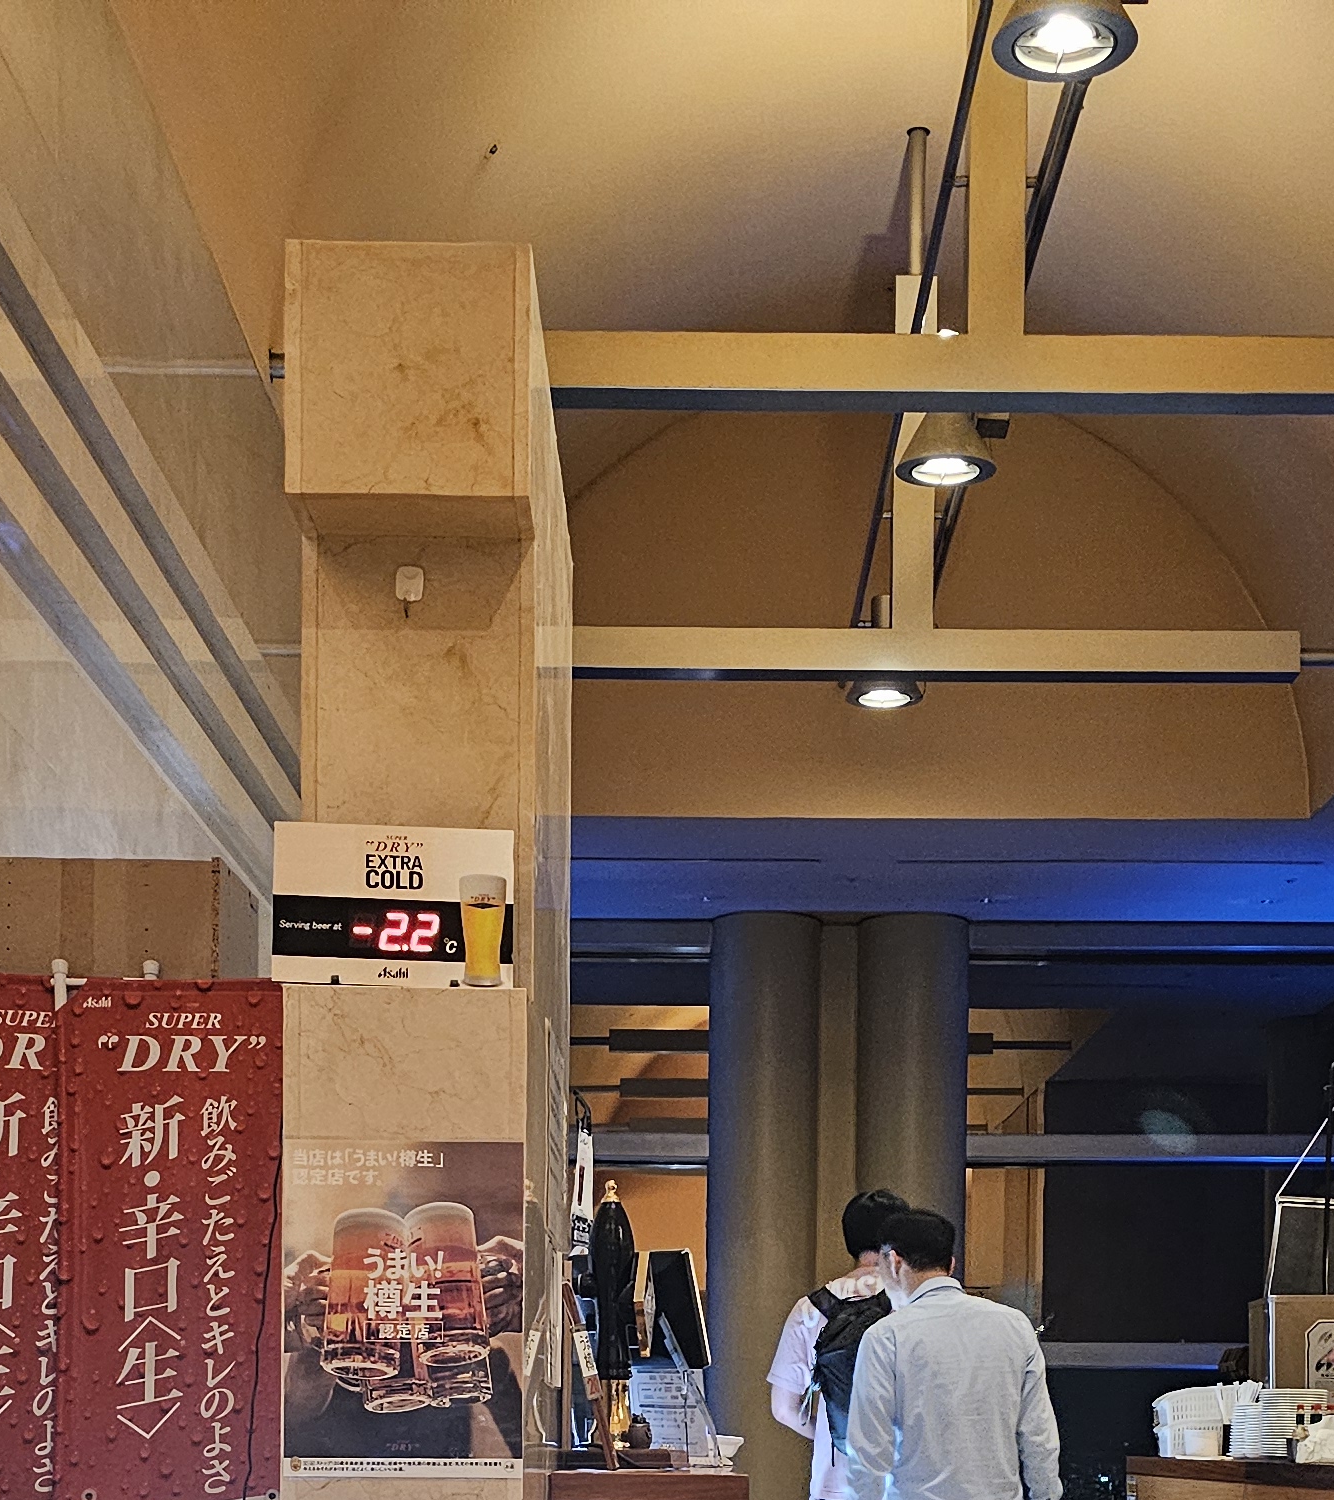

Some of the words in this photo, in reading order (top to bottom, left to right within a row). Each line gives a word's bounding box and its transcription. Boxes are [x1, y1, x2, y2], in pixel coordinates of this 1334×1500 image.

[365, 854, 423, 870] EXTRA
[365, 869, 424, 890] COLD
[279, 919, 310, 932] Serving
[312, 920, 332, 931] beer
[333, 921, 342, 931] at
[377, 966, 410, 980] Asahi
[83, 996, 112, 1008] Asahi
[145, 1012, 222, 1029] SUPER
[292, 1169, 385, 1186] 認定店です。
[199, 1095, 239, 1494] 飲みごたえとキレのよさ
[363, 1280, 443, 1319] 樽生
[378, 1324, 430, 1340] 認定店
